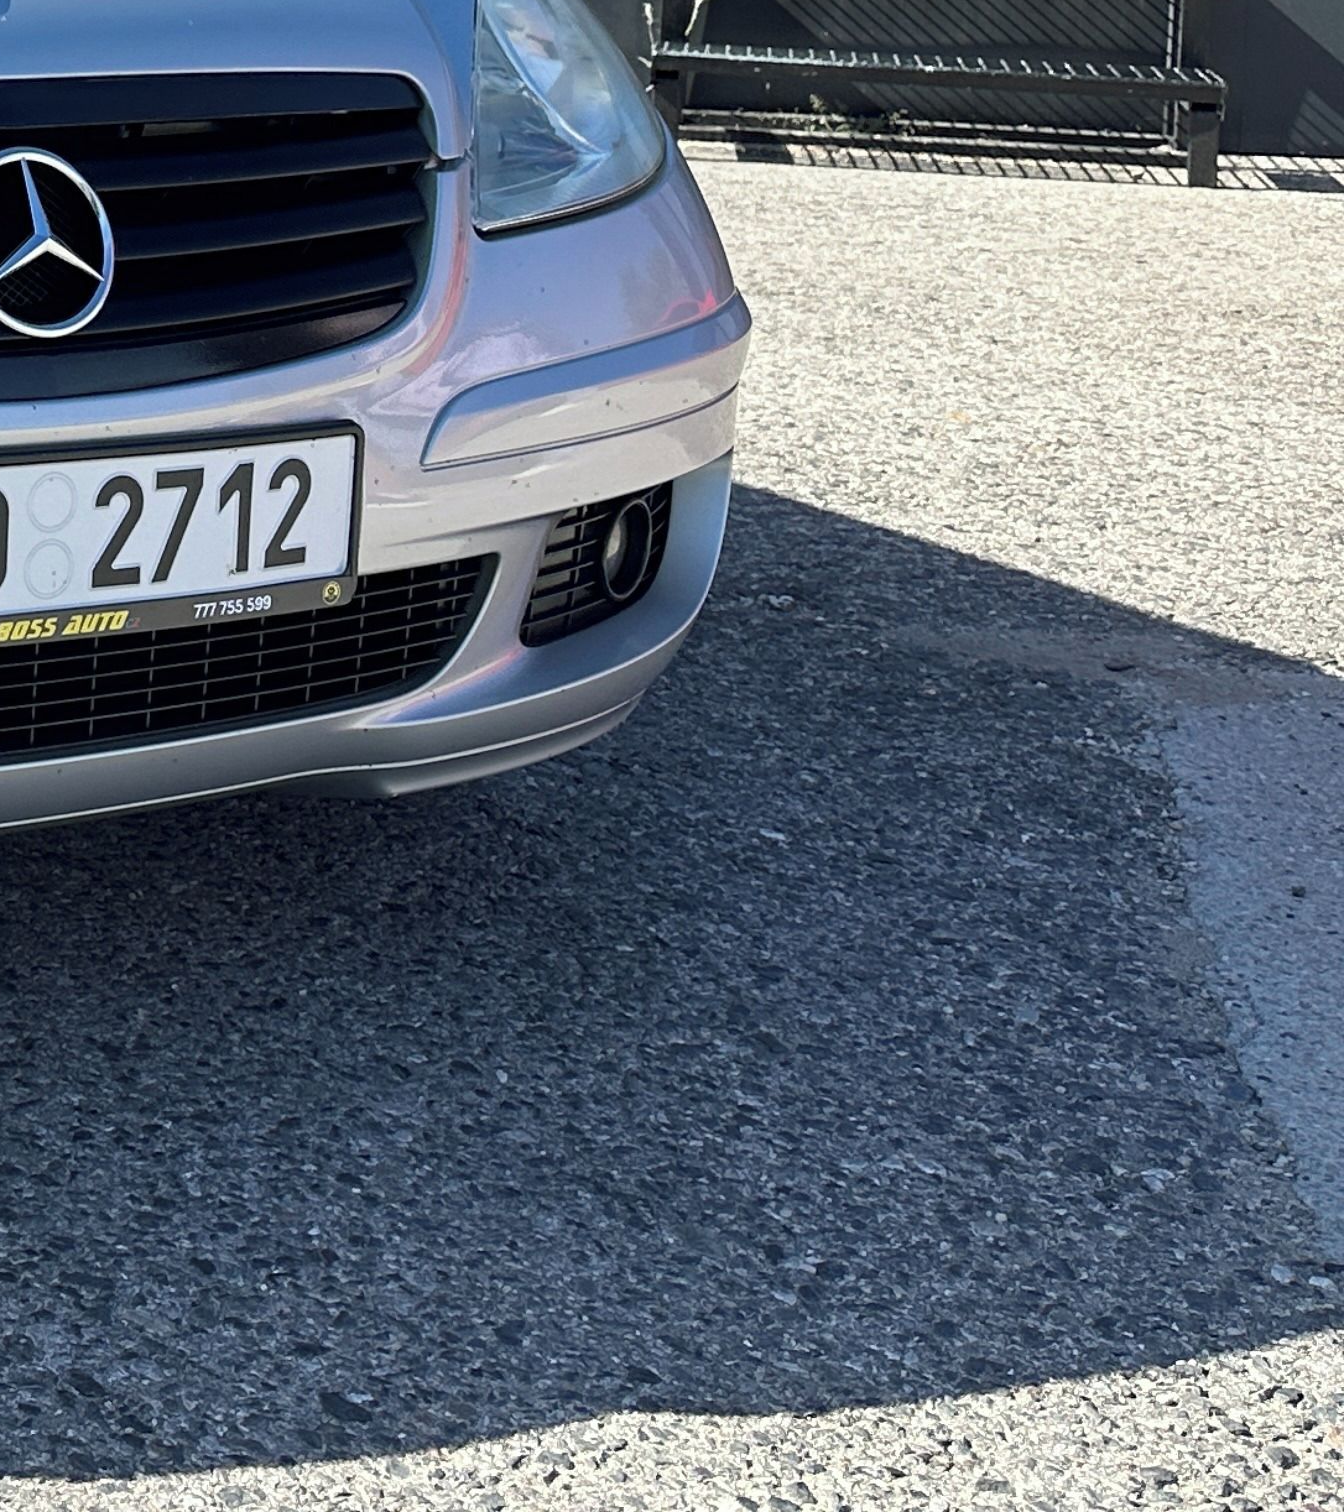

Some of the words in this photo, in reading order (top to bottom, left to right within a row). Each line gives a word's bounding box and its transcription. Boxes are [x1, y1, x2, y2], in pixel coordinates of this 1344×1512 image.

[90, 457, 313, 589] 2712
[61, 610, 130, 636] AUTO
[193, 601, 216, 619] 777
[218, 598, 244, 616] 755
[246, 594, 272, 612] 599
